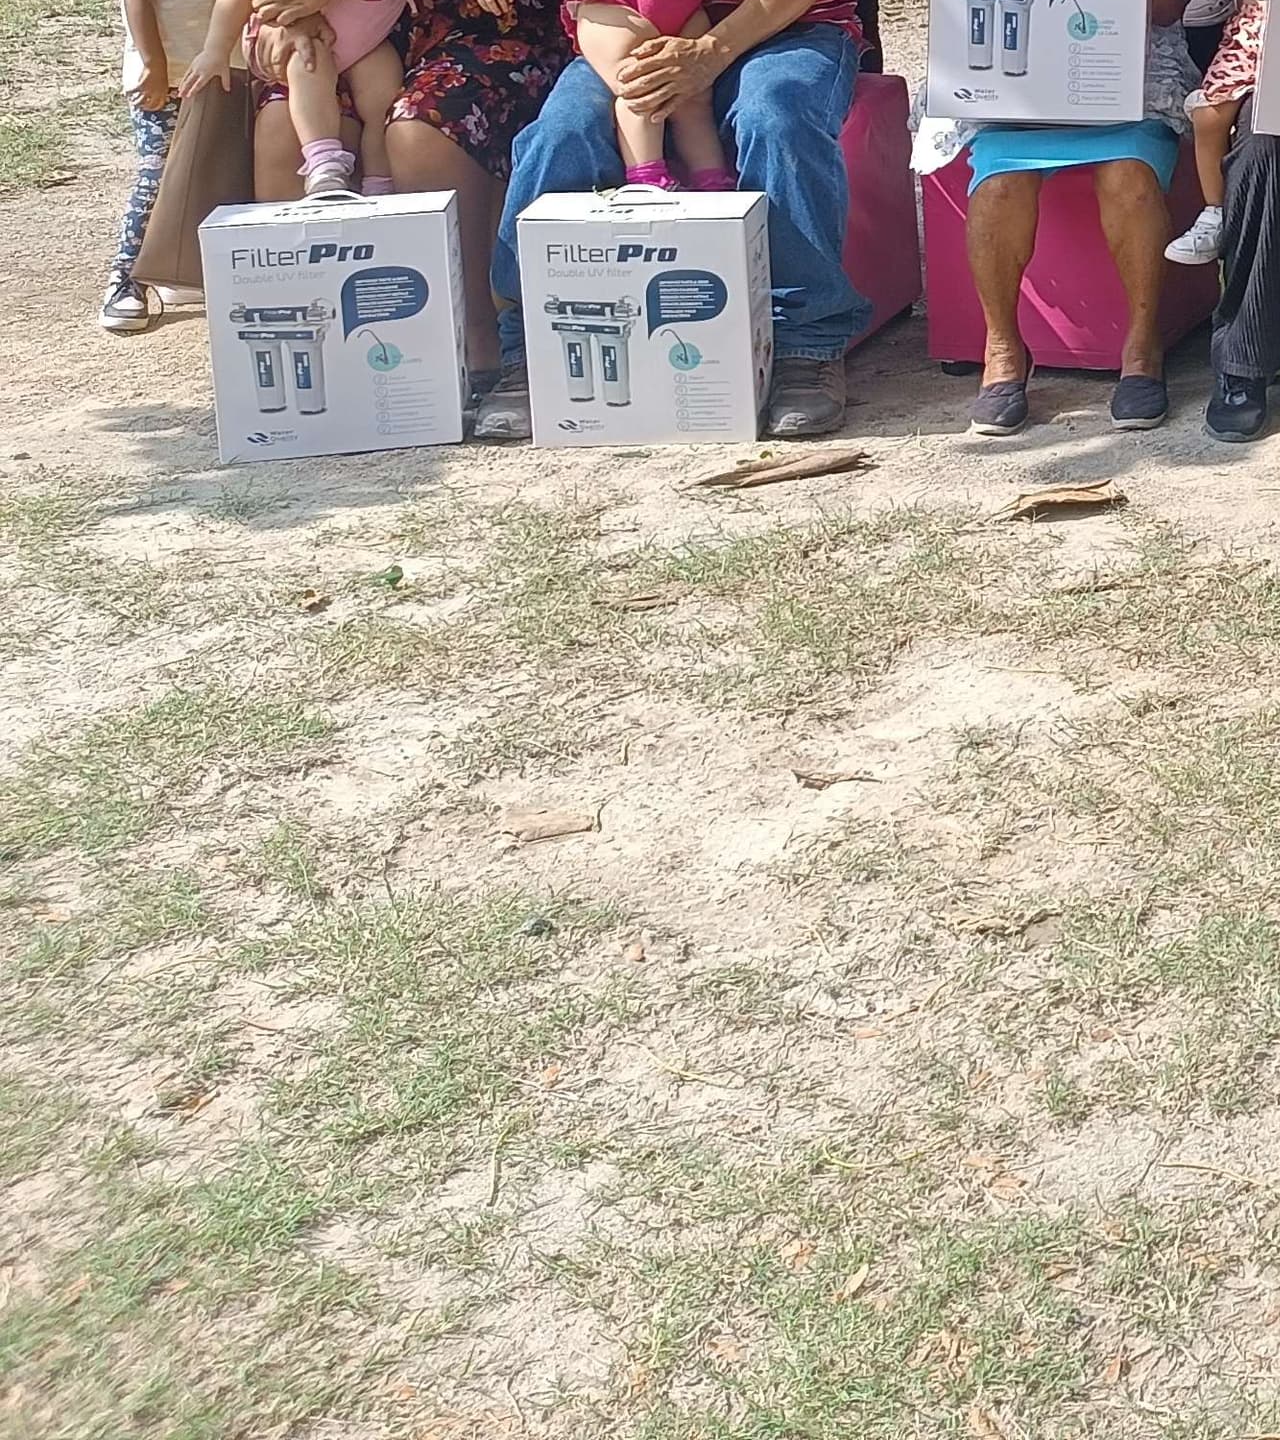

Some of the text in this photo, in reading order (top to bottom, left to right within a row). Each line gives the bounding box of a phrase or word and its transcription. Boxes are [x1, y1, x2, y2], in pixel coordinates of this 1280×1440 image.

[231, 243, 374, 270] FilterPro
[546, 244, 678, 263] FilterPro
[277, 273, 295, 282] UV
[547, 268, 632, 278] Double UV filter
